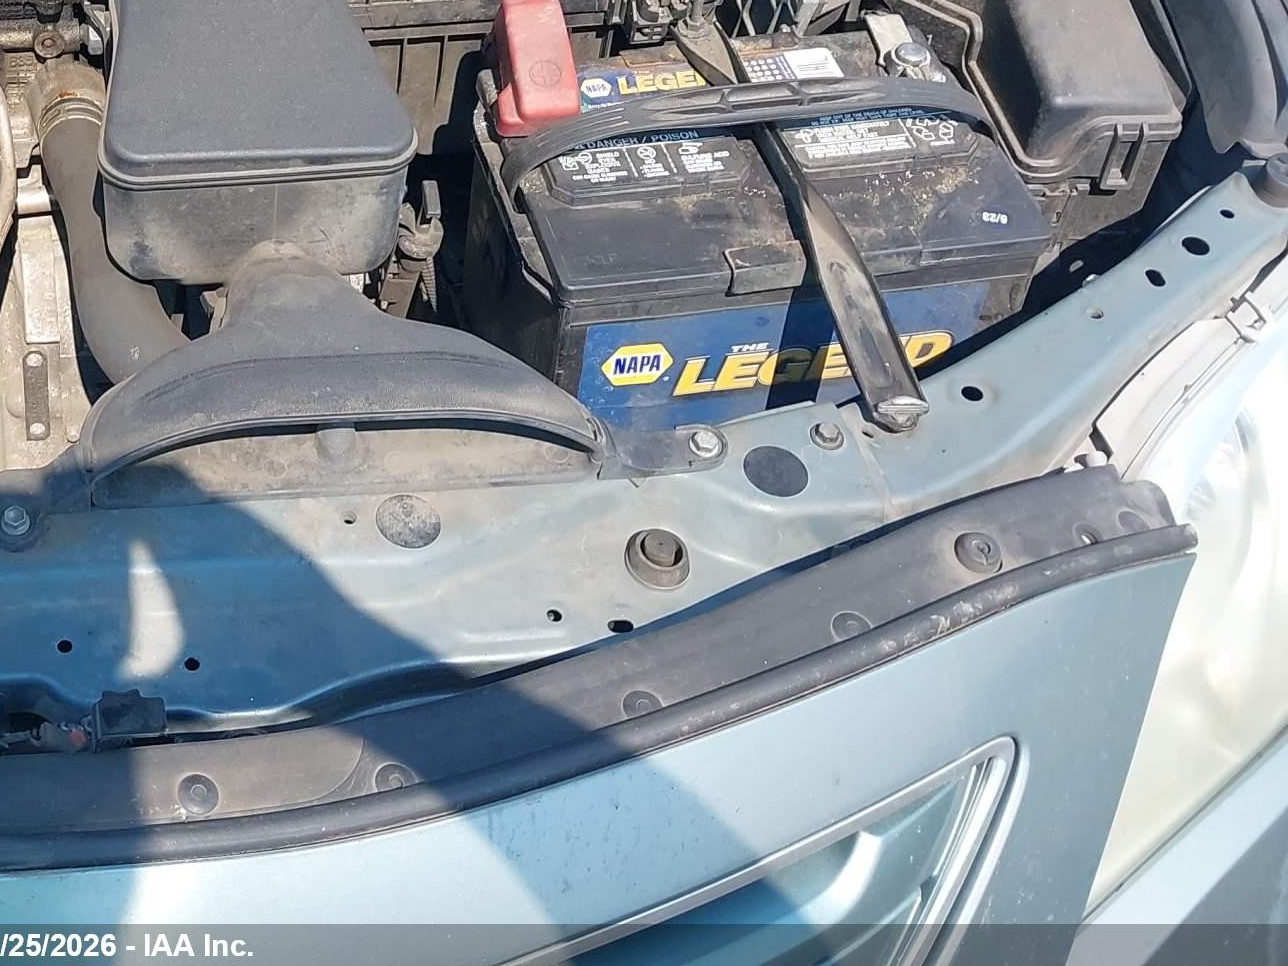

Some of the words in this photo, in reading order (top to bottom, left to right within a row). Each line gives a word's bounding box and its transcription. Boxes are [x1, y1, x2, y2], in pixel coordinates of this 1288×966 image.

[585, 83, 608, 94] NAPA
[588, 137, 638, 150] DANGER
[651, 130, 699, 143] POISON
[730, 342, 770, 353] THE
[612, 354, 662, 375] NAPA
[672, 330, 954, 397] LEGED
